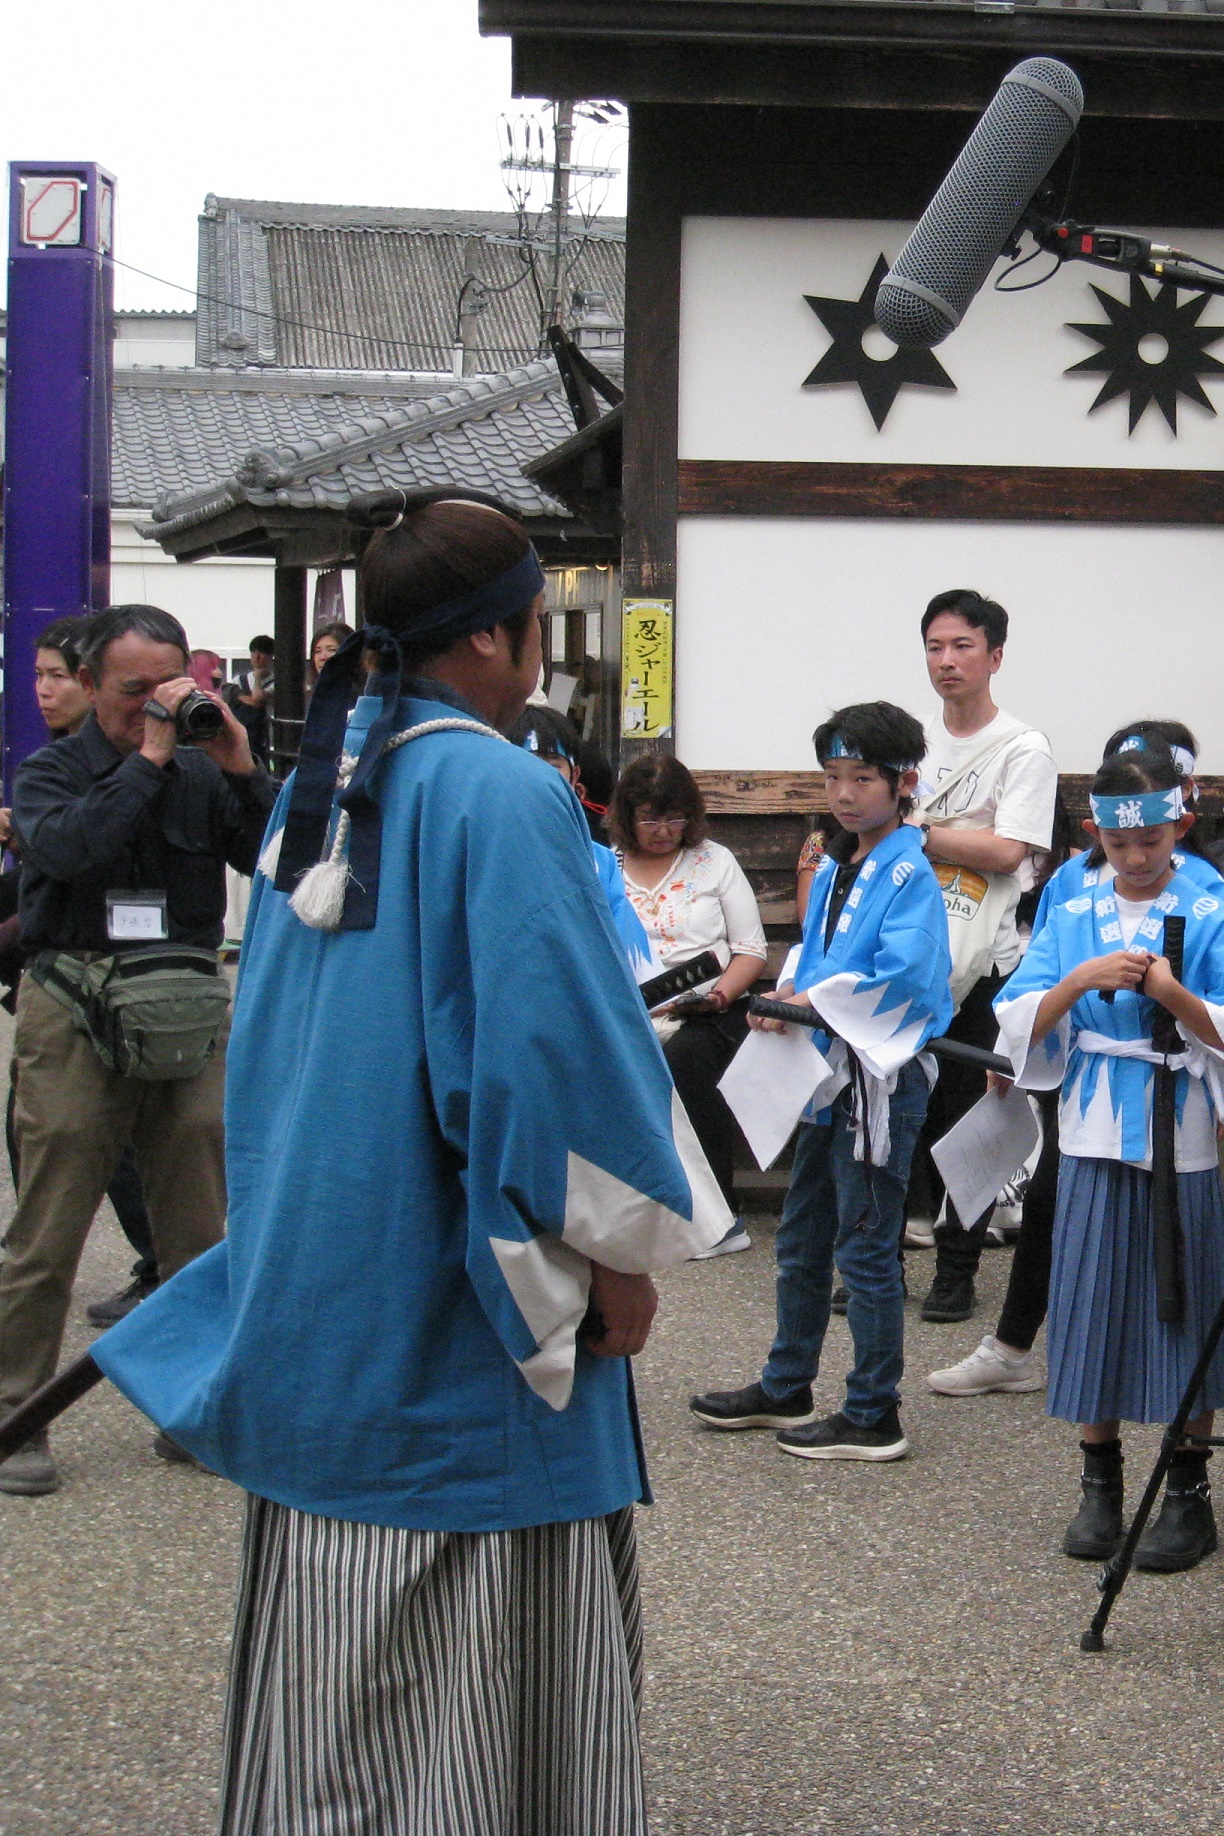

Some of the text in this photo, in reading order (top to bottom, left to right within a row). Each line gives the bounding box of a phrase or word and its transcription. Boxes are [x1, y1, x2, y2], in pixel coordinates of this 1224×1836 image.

[632, 619, 663, 733] 忍ジャーエール
[1114, 799, 1146, 829] 誠
